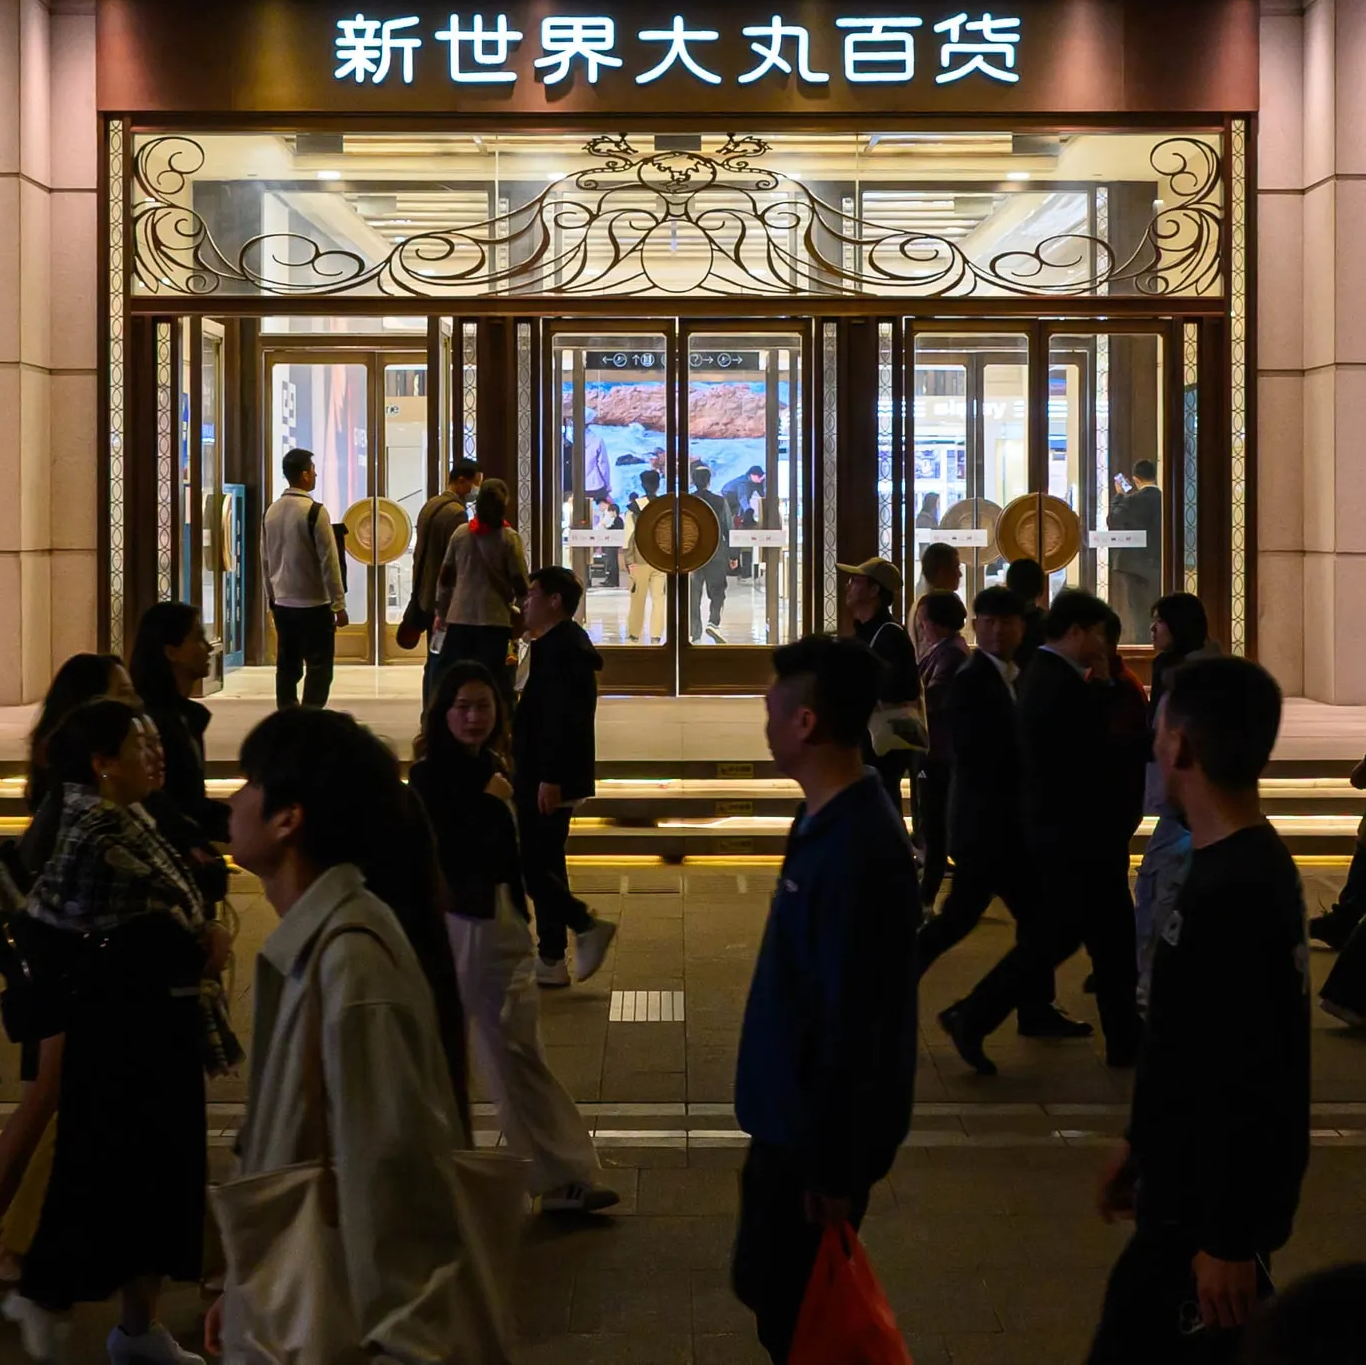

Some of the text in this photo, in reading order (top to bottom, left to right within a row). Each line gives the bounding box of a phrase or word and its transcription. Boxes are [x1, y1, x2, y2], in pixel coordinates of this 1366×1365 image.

[333, 11, 1022, 85] 新世界大丸百货
